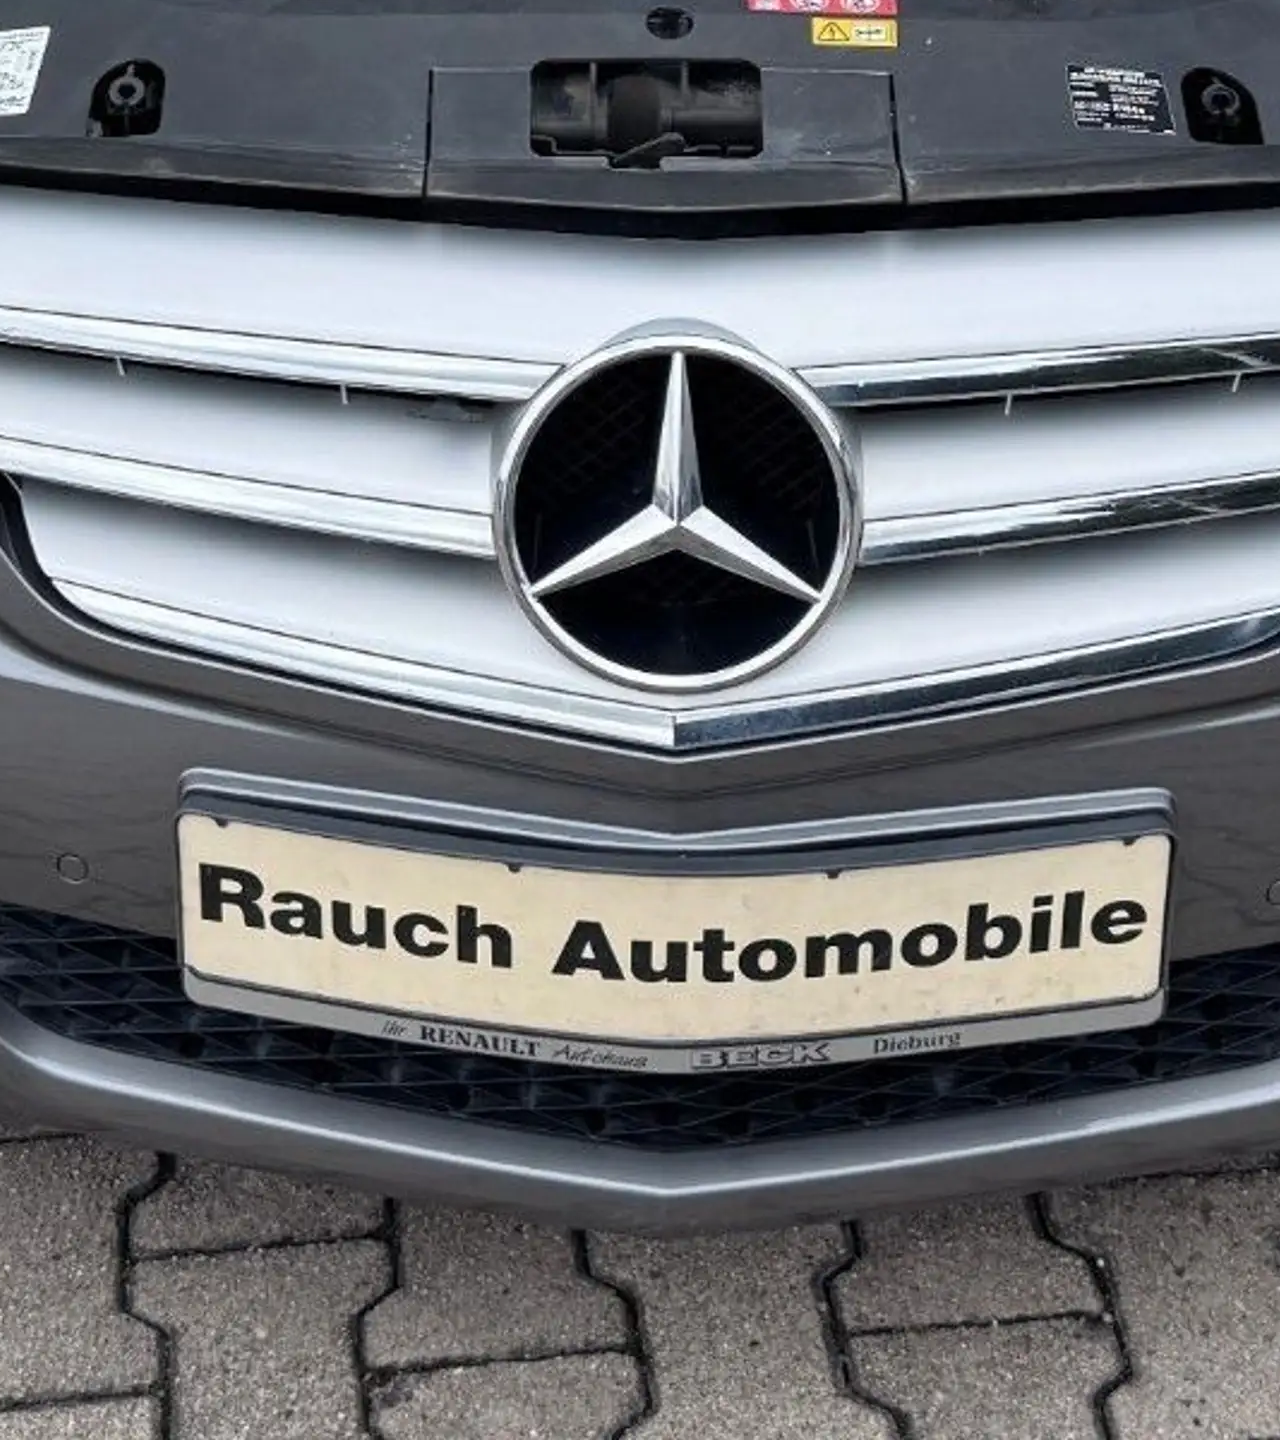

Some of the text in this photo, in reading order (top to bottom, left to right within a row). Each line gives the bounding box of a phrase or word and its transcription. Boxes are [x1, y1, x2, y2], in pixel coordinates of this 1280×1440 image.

[198, 862, 1148, 983] Rauch Automobile
[420, 1024, 541, 1056] RENAULT
[690, 1041, 832, 1070] BECK
[872, 1031, 961, 1055] Dieburg
